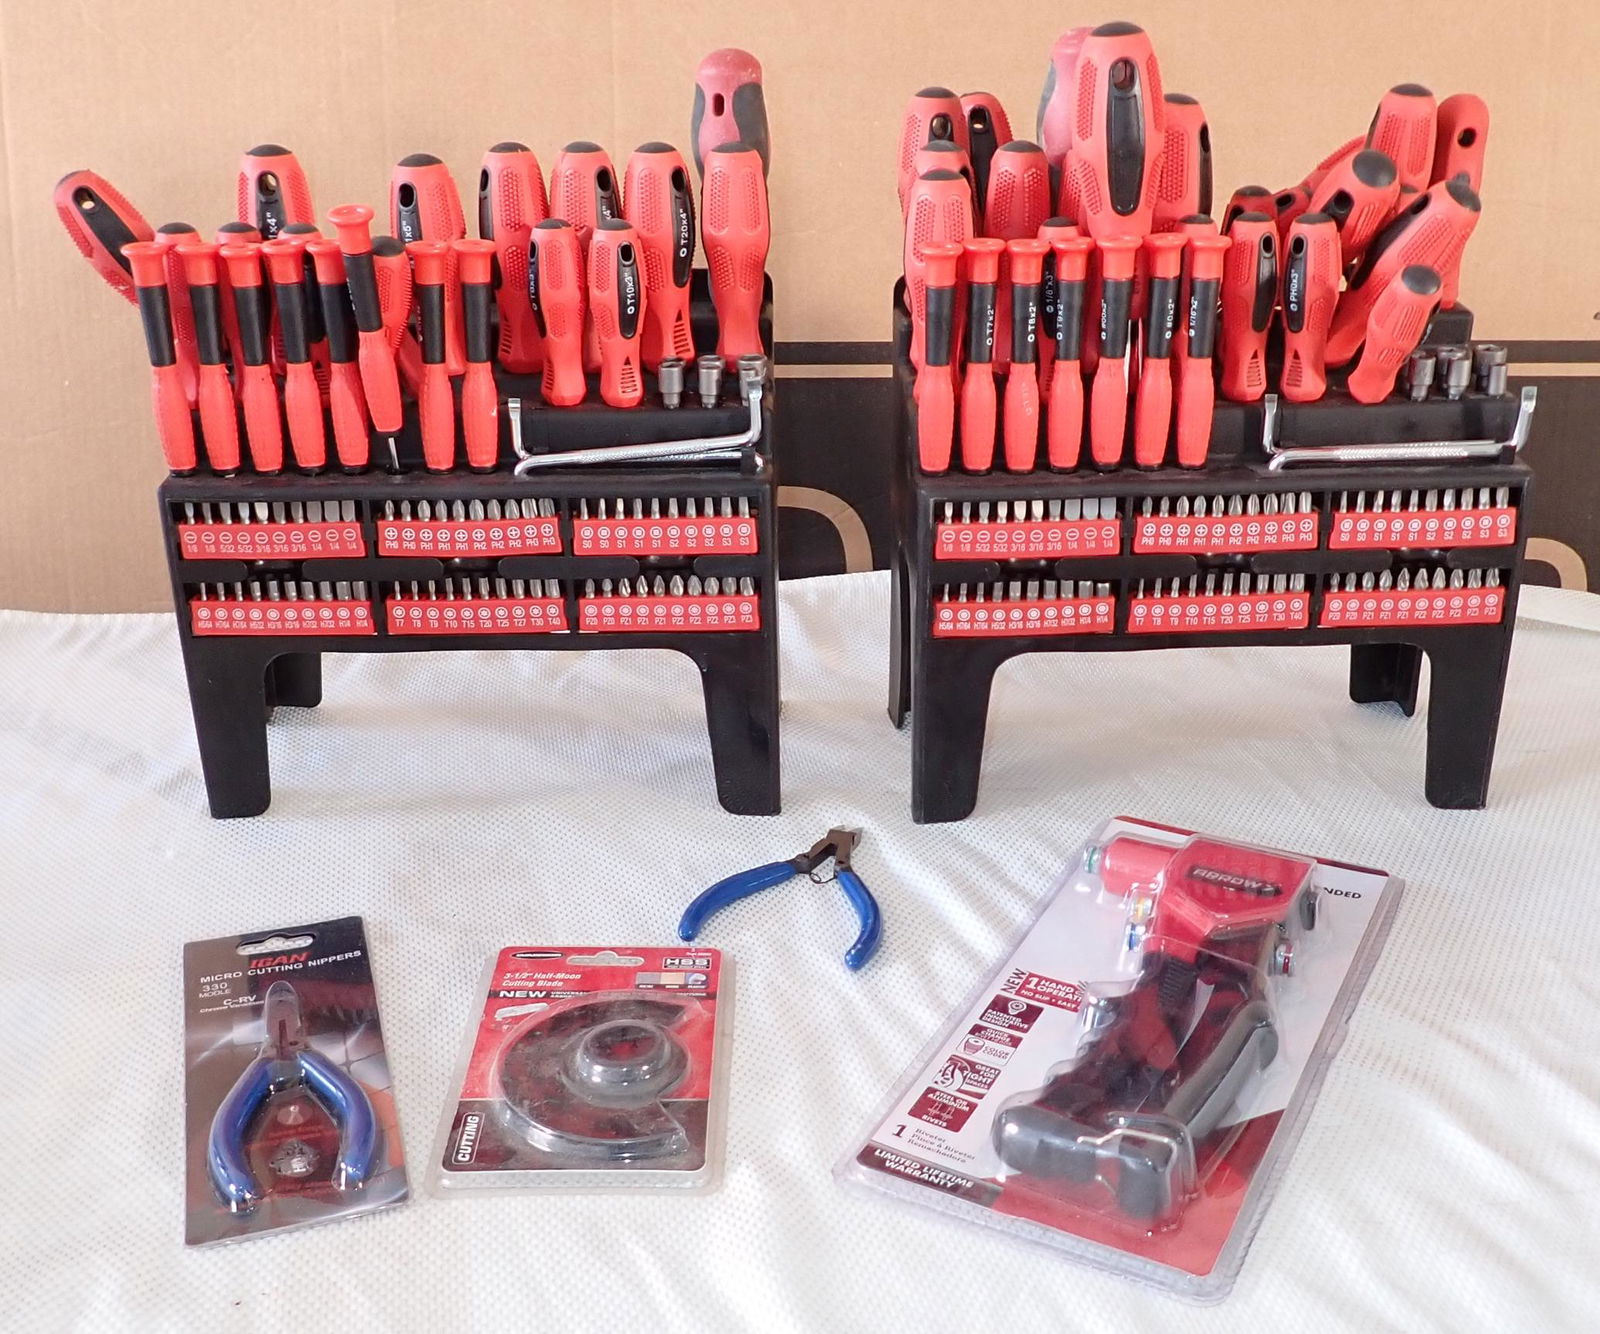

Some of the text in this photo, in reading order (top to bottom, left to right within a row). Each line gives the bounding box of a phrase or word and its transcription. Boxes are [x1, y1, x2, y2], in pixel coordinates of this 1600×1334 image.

[680, 209, 688, 245] T20x4"
[625, 272, 636, 305] T10x3"
[986, 303, 994, 335] T7x2"
[1028, 302, 1036, 334] T8x2"
[1229, 537, 1241, 545] PH2
[1247, 536, 1259, 544] PH2
[1300, 533, 1312, 541] PH3
[1340, 529, 1507, 541] S0 S0 S1 S1 S1 S2 S2 S2 S3 S3
[421, 542, 432, 550] PH1
[474, 542, 487, 550] PH2
[492, 541, 504, 549] PH2
[509, 540, 522, 548] PH2
[687, 539, 696, 547] S2
[976, 544, 990, 552] 5/32
[1029, 543, 1043, 551] 3/16
[1047, 542, 1061, 550] 3/16
[1273, 613, 1285, 621] T30
[1290, 612, 1302, 620] T40
[429, 620, 438, 628] T9
[479, 620, 492, 628] T20
[200, 950, 361, 984] MICRO CUTTING NIPPERS
[533, 972, 582, 980] Half-Moon
[1000, 968, 1027, 994] NEW
[202, 982, 228, 992] 330
[502, 979, 536, 988] Cutting
[1026, 977, 1040, 990] 1
[1040, 979, 1074, 993] HAND
[499, 990, 547, 998] NEW
[1058, 999, 1076, 1008] EASY
[975, 1064, 1000, 1074] GREAT
[963, 1070, 993, 1084] TIGHT
[922, 1114, 948, 1128] RIVETS
[892, 1124, 907, 1138] 1
[457, 1114, 480, 1162] CUTTING
[874, 1148, 921, 1170] LIMITED
[922, 1166, 974, 1188] LIFETIME
[885, 1159, 957, 1188] WARRANTY
